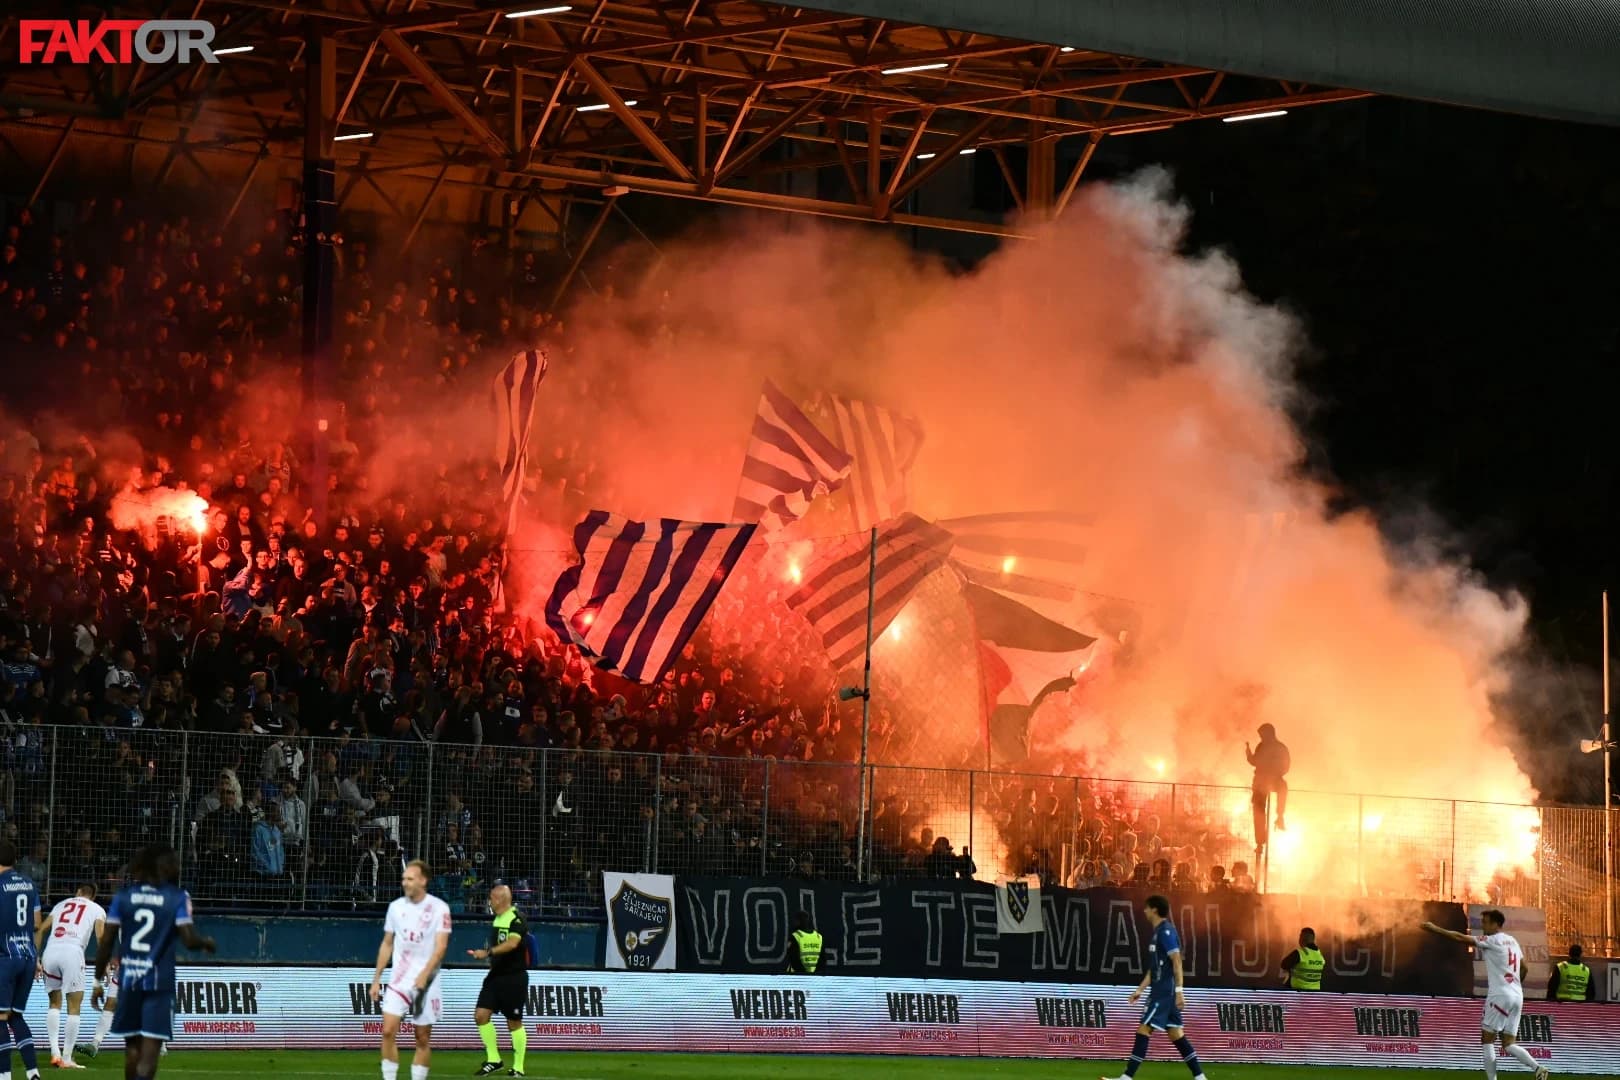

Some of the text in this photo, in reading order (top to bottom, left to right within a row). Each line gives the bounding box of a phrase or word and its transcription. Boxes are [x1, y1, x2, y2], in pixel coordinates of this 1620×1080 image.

[16, 893, 28, 926] 8
[59, 902, 86, 925] 21
[624, 903, 663, 924] SARAJEVO
[130, 908, 155, 952] 2
[911, 890, 999, 968] TE
[627, 954, 650, 967] 1921
[1508, 947, 1517, 972] 4
[730, 989, 808, 1020] WEIDER
[886, 992, 960, 1024] WEIDER
[1035, 997, 1106, 1028] WEIDER
[1216, 1002, 1285, 1032] WEIDER
[1353, 1007, 1420, 1037] WEIDER
